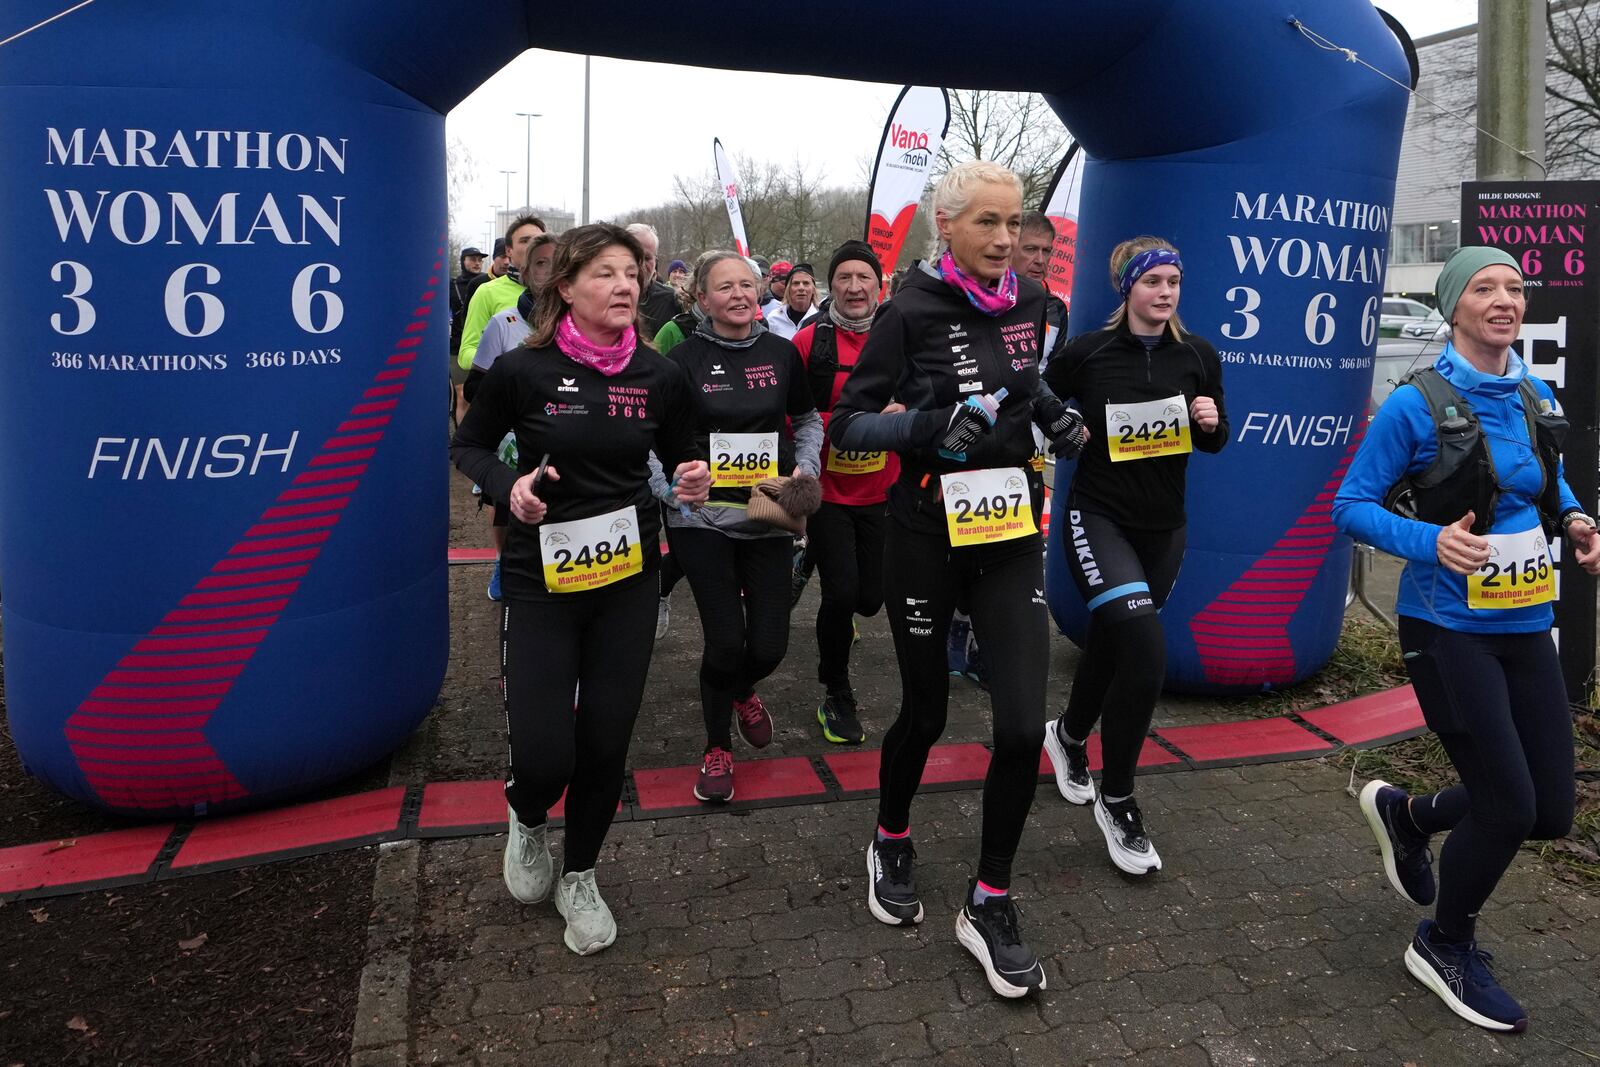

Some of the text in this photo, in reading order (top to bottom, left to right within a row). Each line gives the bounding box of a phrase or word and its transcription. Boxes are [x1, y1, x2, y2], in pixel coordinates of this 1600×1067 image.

[892, 123, 928, 149] Vano
[46, 127, 348, 175] MARATHON
[903, 152, 928, 167] mobil
[1479, 192, 1541, 200] HILDE DOSOGNE
[43, 188, 345, 246] WOMAN
[1232, 191, 1391, 232] MARATHON
[1478, 203, 1587, 219] MARATHON
[1478, 224, 1586, 245] WOMAN
[1227, 234, 1385, 284] WOMAN
[1521, 249, 1585, 276] 6 6
[50, 260, 344, 337] 3 6 6
[1220, 286, 1378, 347] 3 6 6
[948, 331, 968, 339] erima
[1000, 321, 1035, 333] MARATHON
[1002, 330, 1036, 344] WOMAN
[1005, 339, 1038, 355] 3 6 6
[51, 348, 341, 371] 366 MARATHONS 366 DAYS
[744, 364, 774, 372] MARATHON
[1219, 350, 1245, 364] 366
[1249, 352, 1333, 370] MARATHONS
[1339, 357, 1355, 369] 366
[745, 370, 776, 381] WOMAN
[747, 377, 778, 390] 3 6 6
[608, 386, 649, 395] MARATHON
[608, 394, 648, 406] WOMAN
[608, 404, 646, 419] 3 6 6
[1118, 417, 1180, 444] 2421
[1237, 412, 1354, 447] FINISH
[87, 430, 299, 480] FINISH
[1118, 444, 1151, 454] Marathon
[1163, 439, 1181, 448] More
[717, 452, 771, 471] 2486
[716, 472, 745, 480] Marathon
[954, 493, 1023, 524] 2497
[957, 521, 1024, 536] Marathon and More
[553, 534, 631, 574] 2484
[1070, 510, 1104, 586] DAIKIN
[558, 562, 631, 586] Marathon and More
[1480, 554, 1548, 587] 2155
[1481, 584, 1549, 599] Marathon and More
